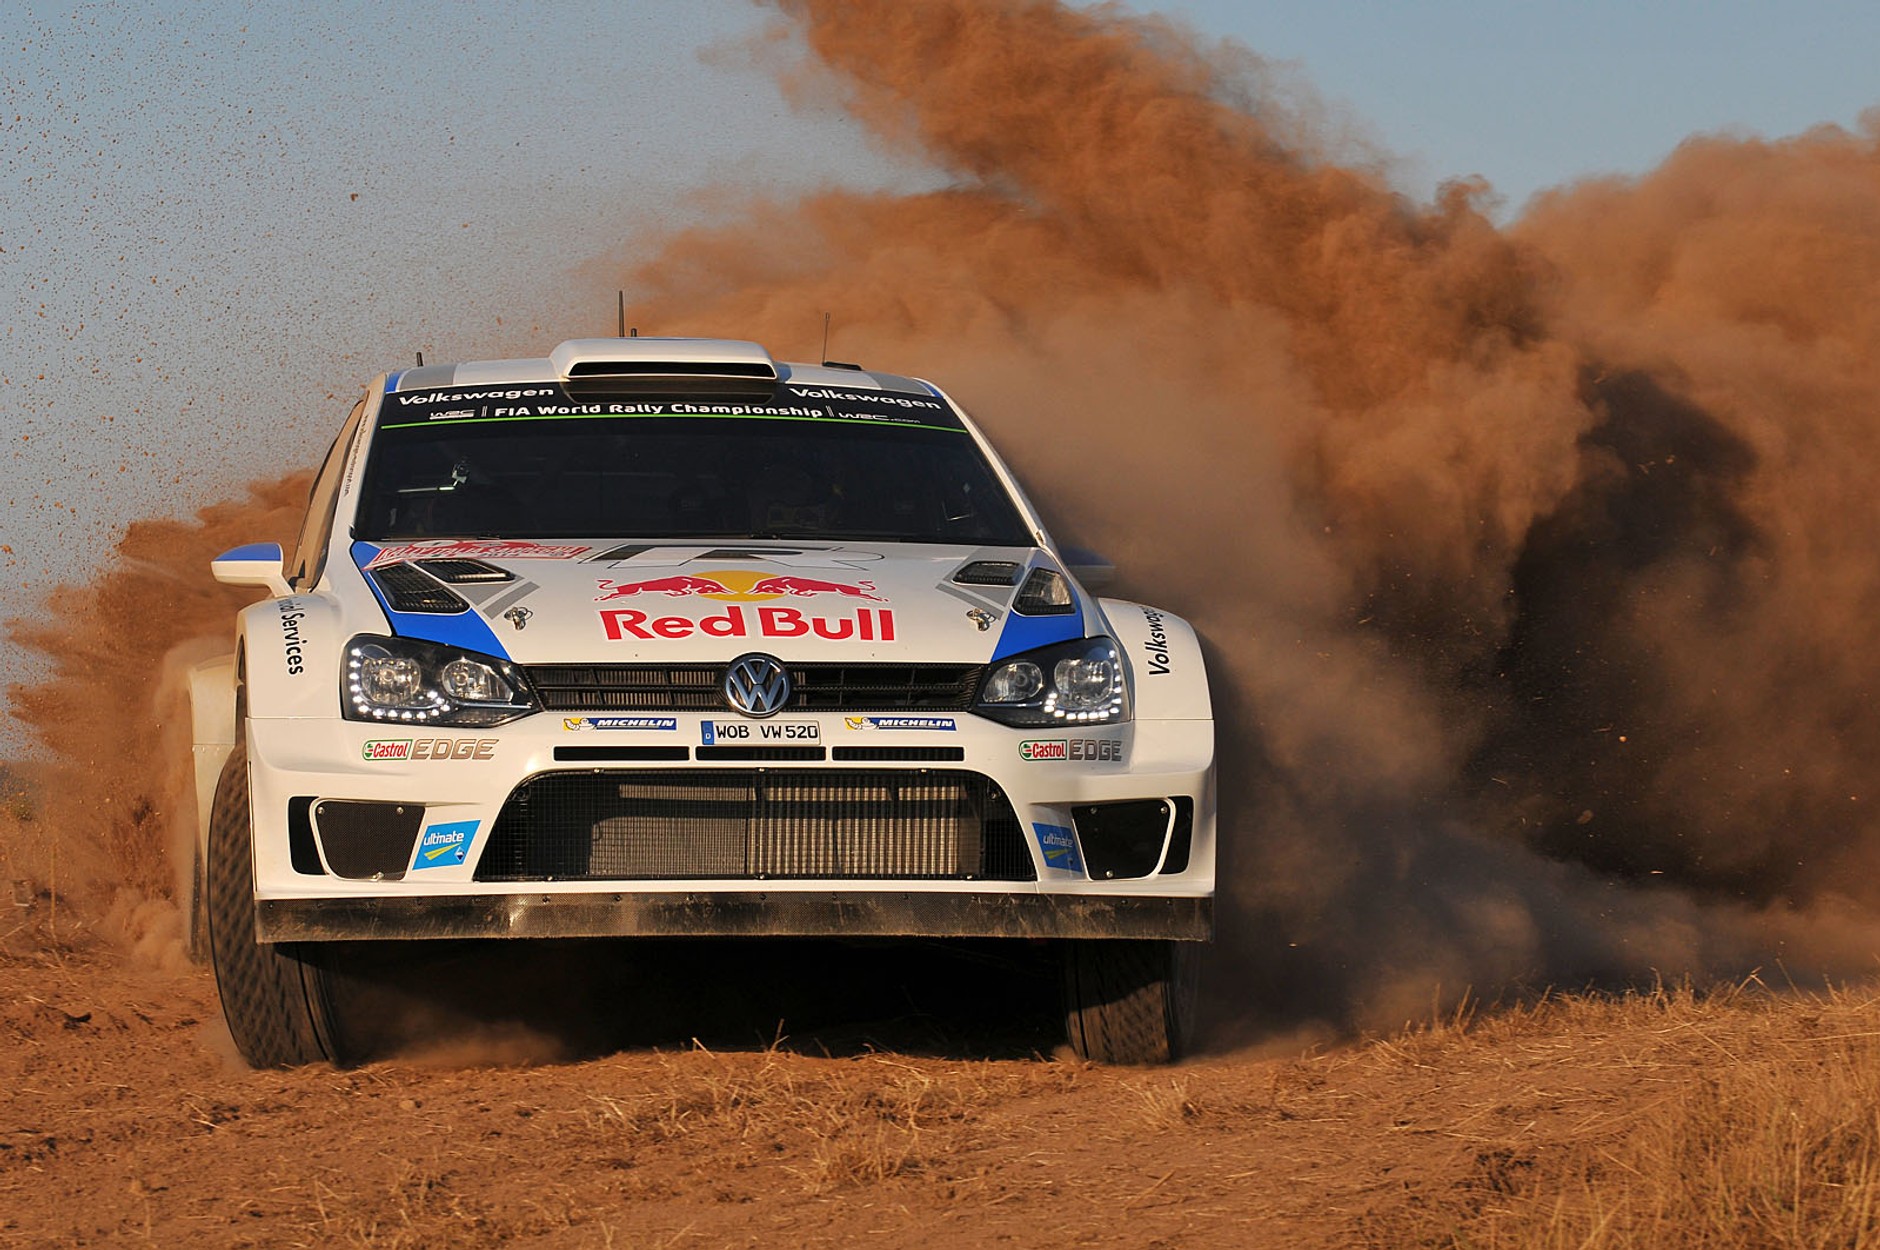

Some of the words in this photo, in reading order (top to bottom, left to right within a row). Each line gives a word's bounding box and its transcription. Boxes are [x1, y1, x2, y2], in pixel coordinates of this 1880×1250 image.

[399, 388, 554, 406] Volkswagen
[789, 387, 941, 410] Volkswagen
[494, 407, 530, 417] FIA
[537, 406, 601, 415] World
[609, 405, 664, 415] Rally
[671, 404, 823, 418] Championship
[599, 606, 747, 640] Red
[757, 607, 896, 641] Bull
[282, 611, 307, 676] Services
[597, 718, 675, 727] MICHELIN
[878, 718, 954, 728] MICHELIN
[716, 725, 750, 738] WOB
[760, 725, 782, 738] VW
[785, 725, 818, 738] 520
[373, 741, 409, 759] Castrol
[411, 738, 499, 760] EDGE
[1032, 743, 1065, 758] Castrol
[1069, 739, 1122, 761] EDGE
[423, 830, 464, 846] ultimate
[1043, 832, 1073, 848] ultimate
